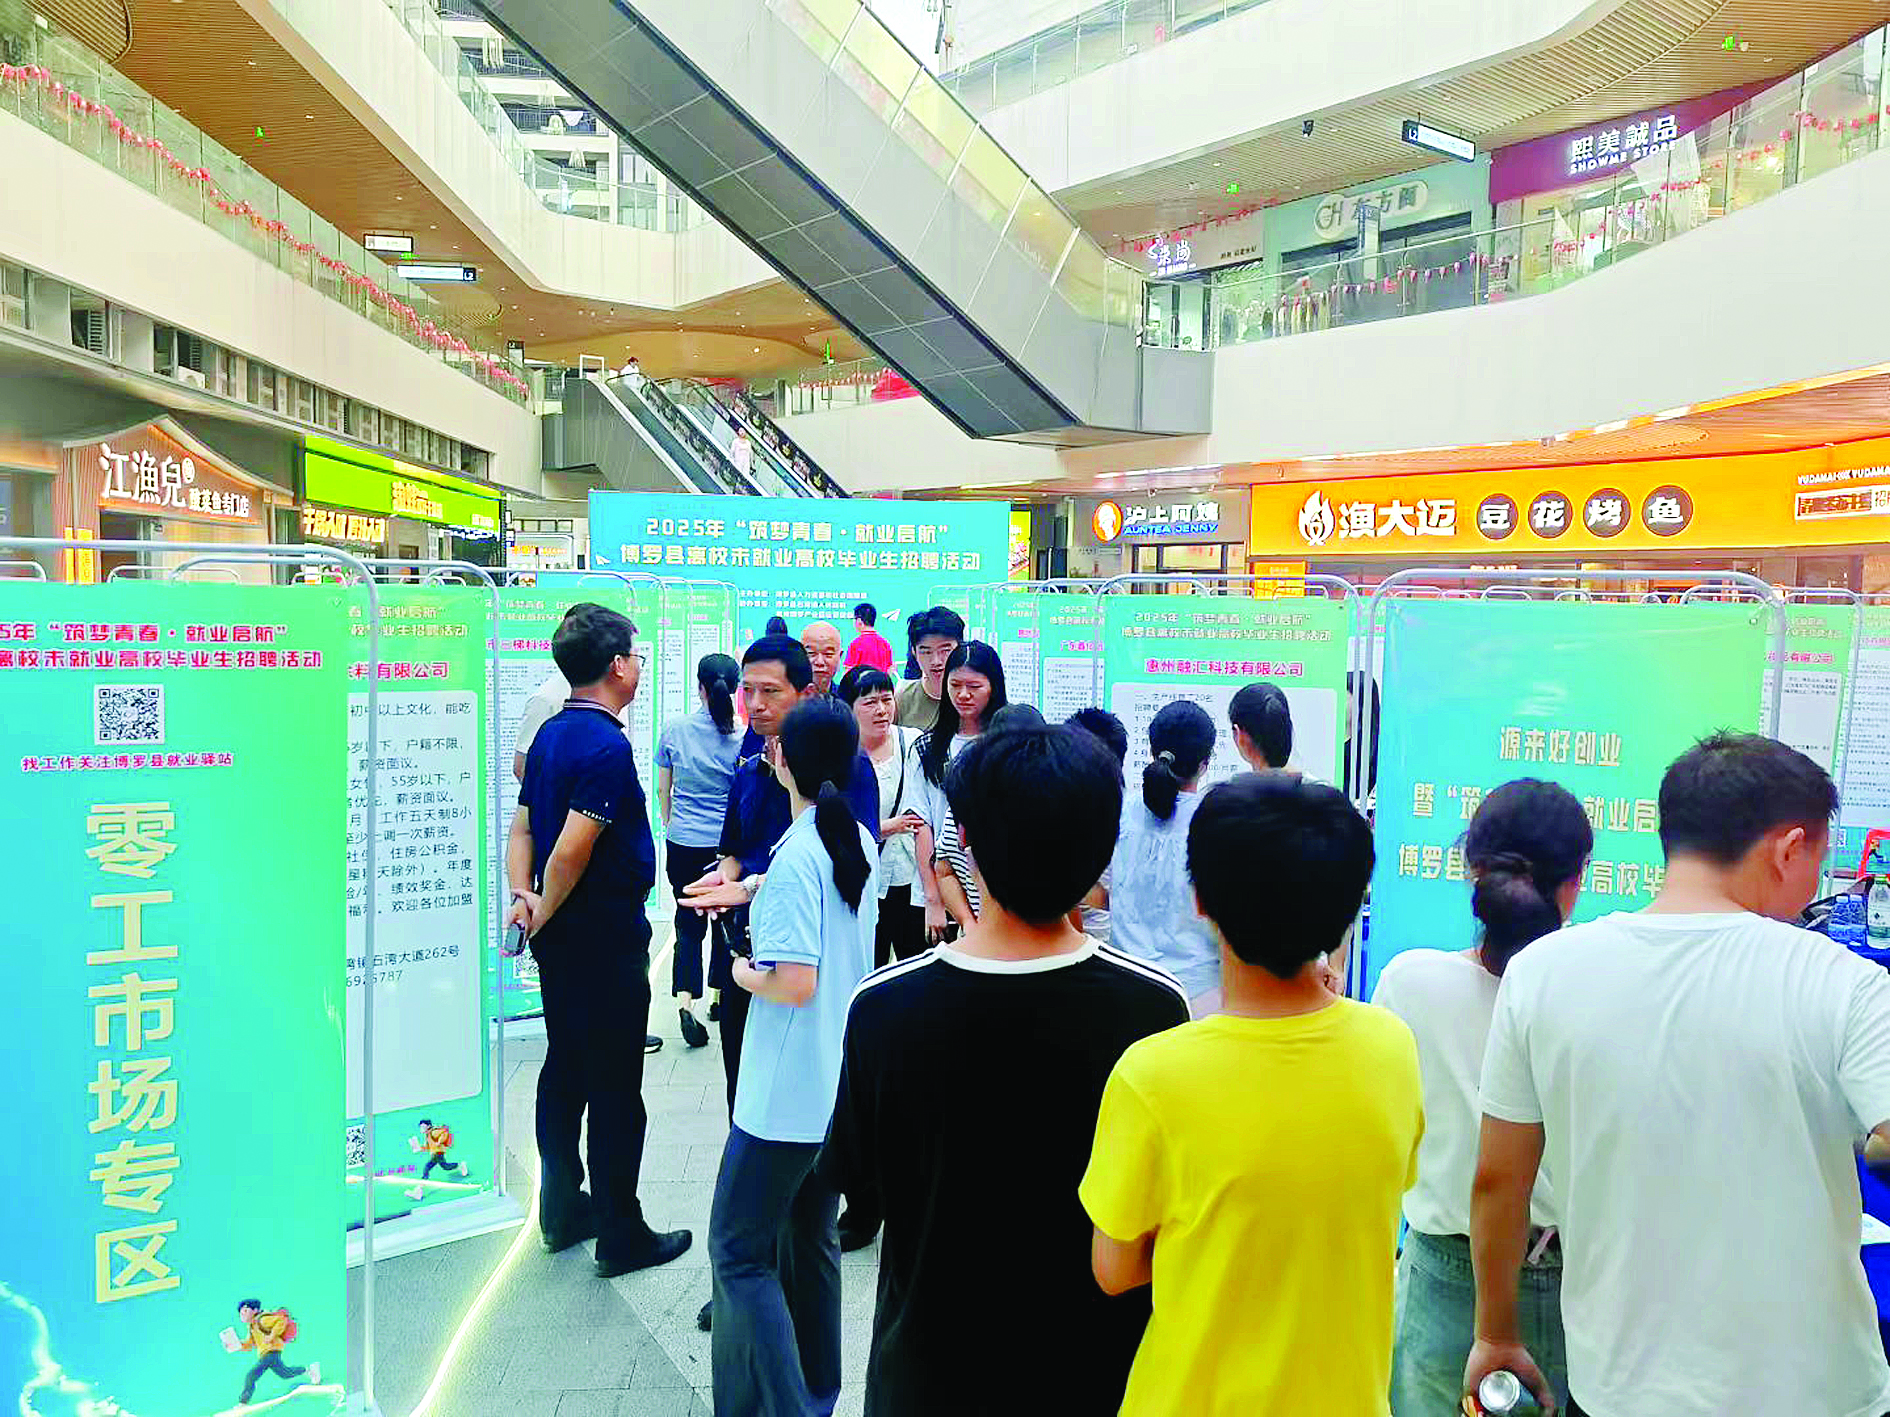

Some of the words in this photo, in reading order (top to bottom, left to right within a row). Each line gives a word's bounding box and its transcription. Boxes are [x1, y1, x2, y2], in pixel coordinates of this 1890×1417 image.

[1571, 114, 1678, 162] 熙美誠品
[1570, 152, 1628, 175] SHOWME
[1633, 140, 1676, 158] STORE
[98, 442, 187, 508] 江漁兒
[1123, 500, 1220, 526] 沪上阿姨
[1479, 496, 1684, 529] 豆花烤鱼
[1123, 524, 1172, 535] AUNTEA
[1176, 523, 1219, 534] JENNY
[620, 543, 982, 570] 博罗县离校未就业高校毕业生招聘活动
[351, 624, 468, 637] 校业生招聘活动
[1144, 658, 1305, 678] 惠州融汇科技有限公司
[22, 751, 234, 772] 找工作关注博罗县就业驿站
[1499, 726, 1623, 767] 源来好创业
[85, 800, 181, 1304] 零工市场专区
